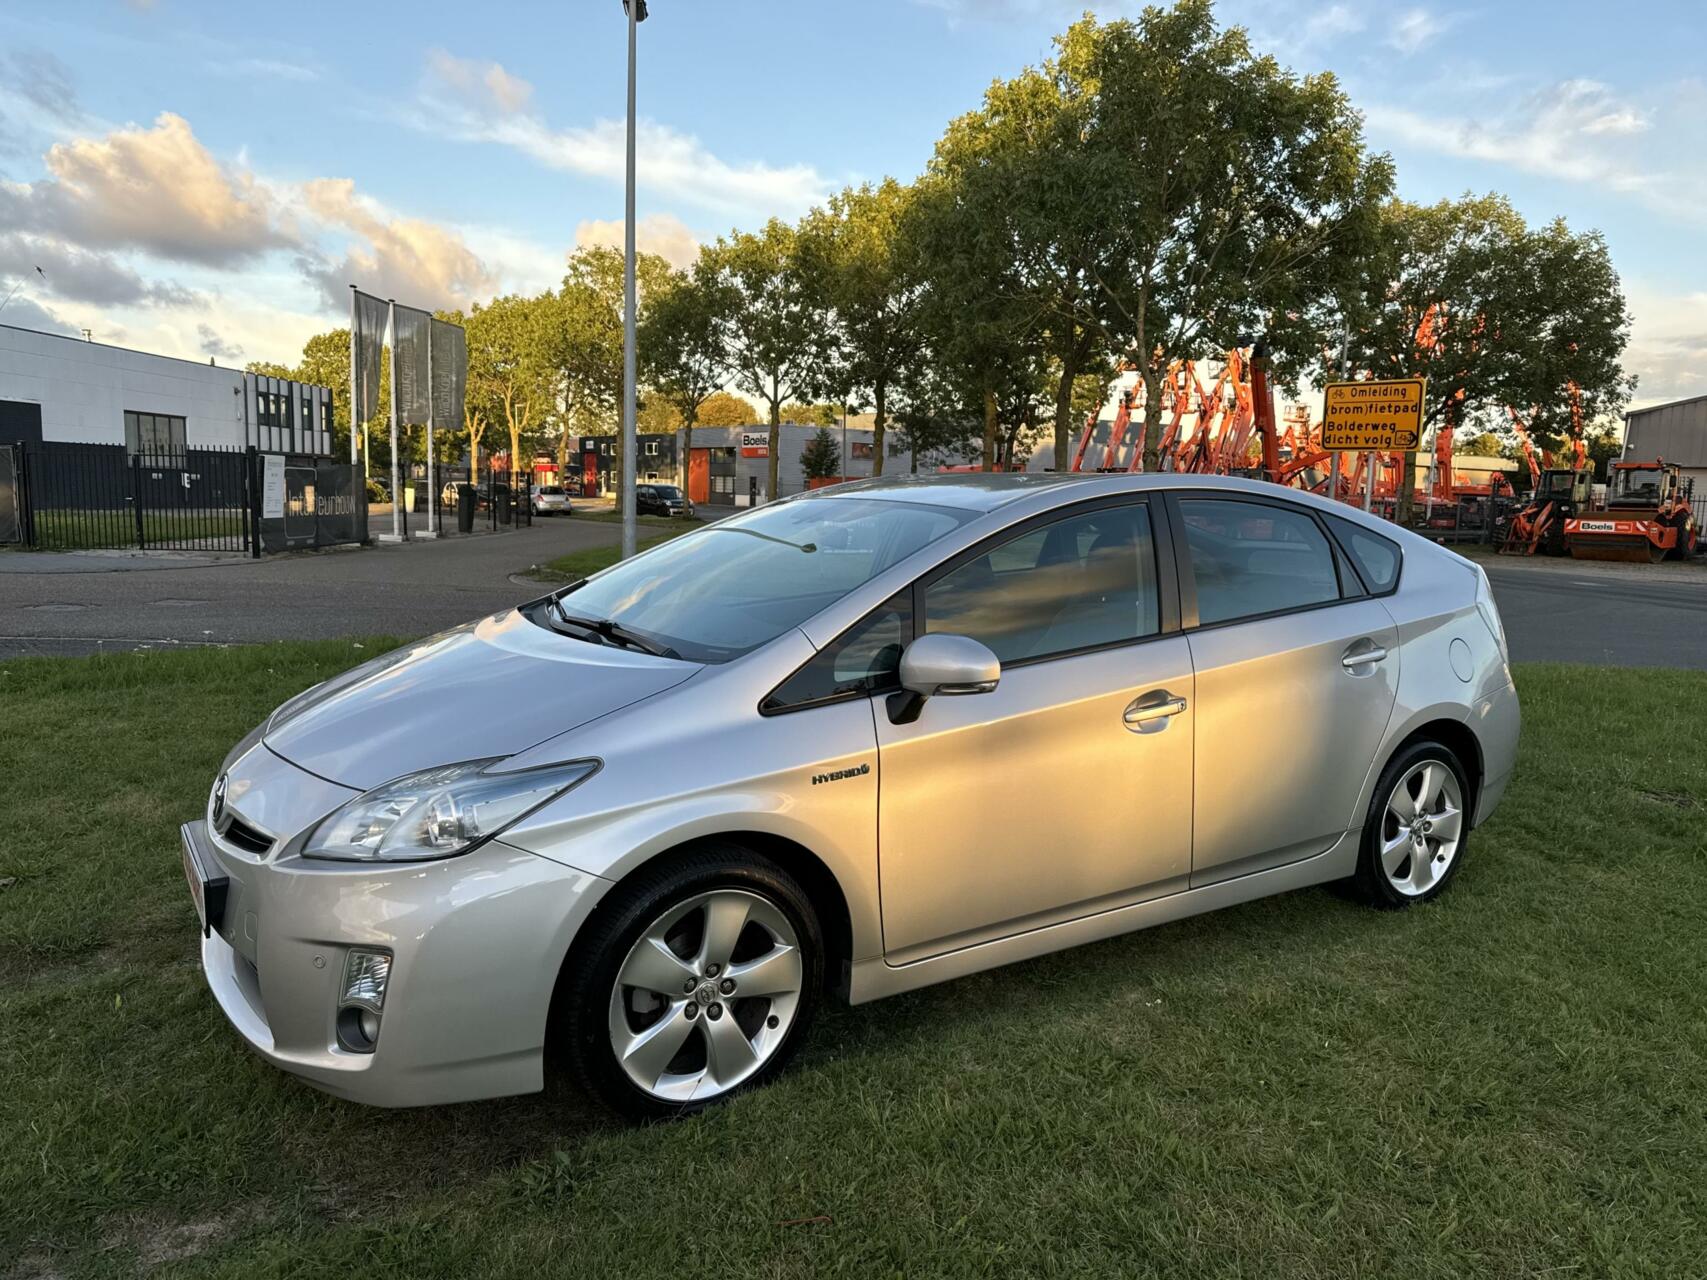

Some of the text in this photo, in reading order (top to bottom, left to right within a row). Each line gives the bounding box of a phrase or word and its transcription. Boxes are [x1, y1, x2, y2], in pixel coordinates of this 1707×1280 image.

[1351, 387, 1407, 398] Omleiding
[1327, 421, 1397, 434] Bolderweg
[743, 434, 767, 446] Boels
[1324, 434, 1392, 448] dicht volg
[1581, 522, 1613, 530] Boels
[812, 766, 861, 785] HYBRID
